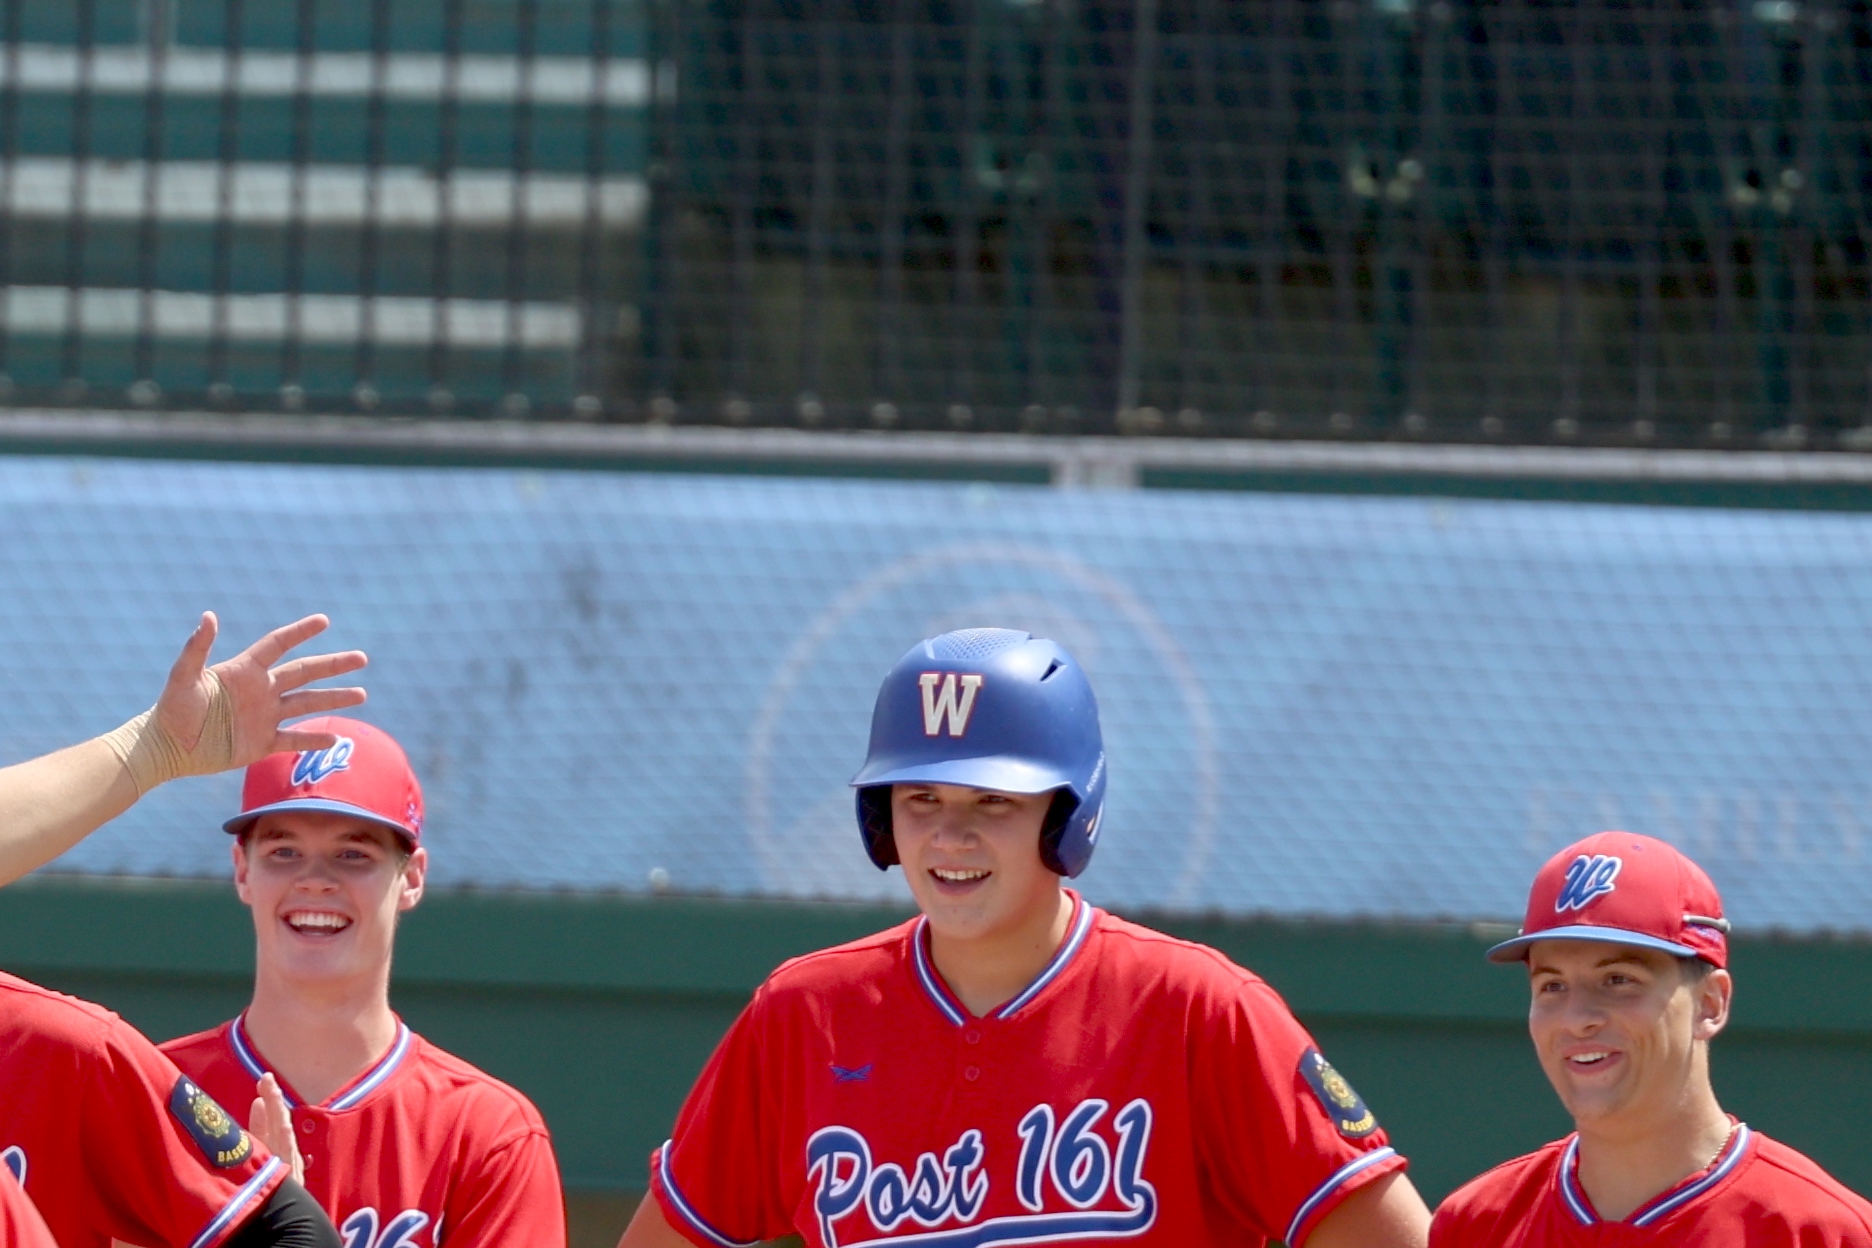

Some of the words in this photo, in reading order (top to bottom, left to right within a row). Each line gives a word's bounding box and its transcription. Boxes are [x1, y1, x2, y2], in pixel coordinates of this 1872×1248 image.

[918, 672, 984, 737] W
[1554, 854, 1622, 914] W
[1016, 1097, 1154, 1212] 161
